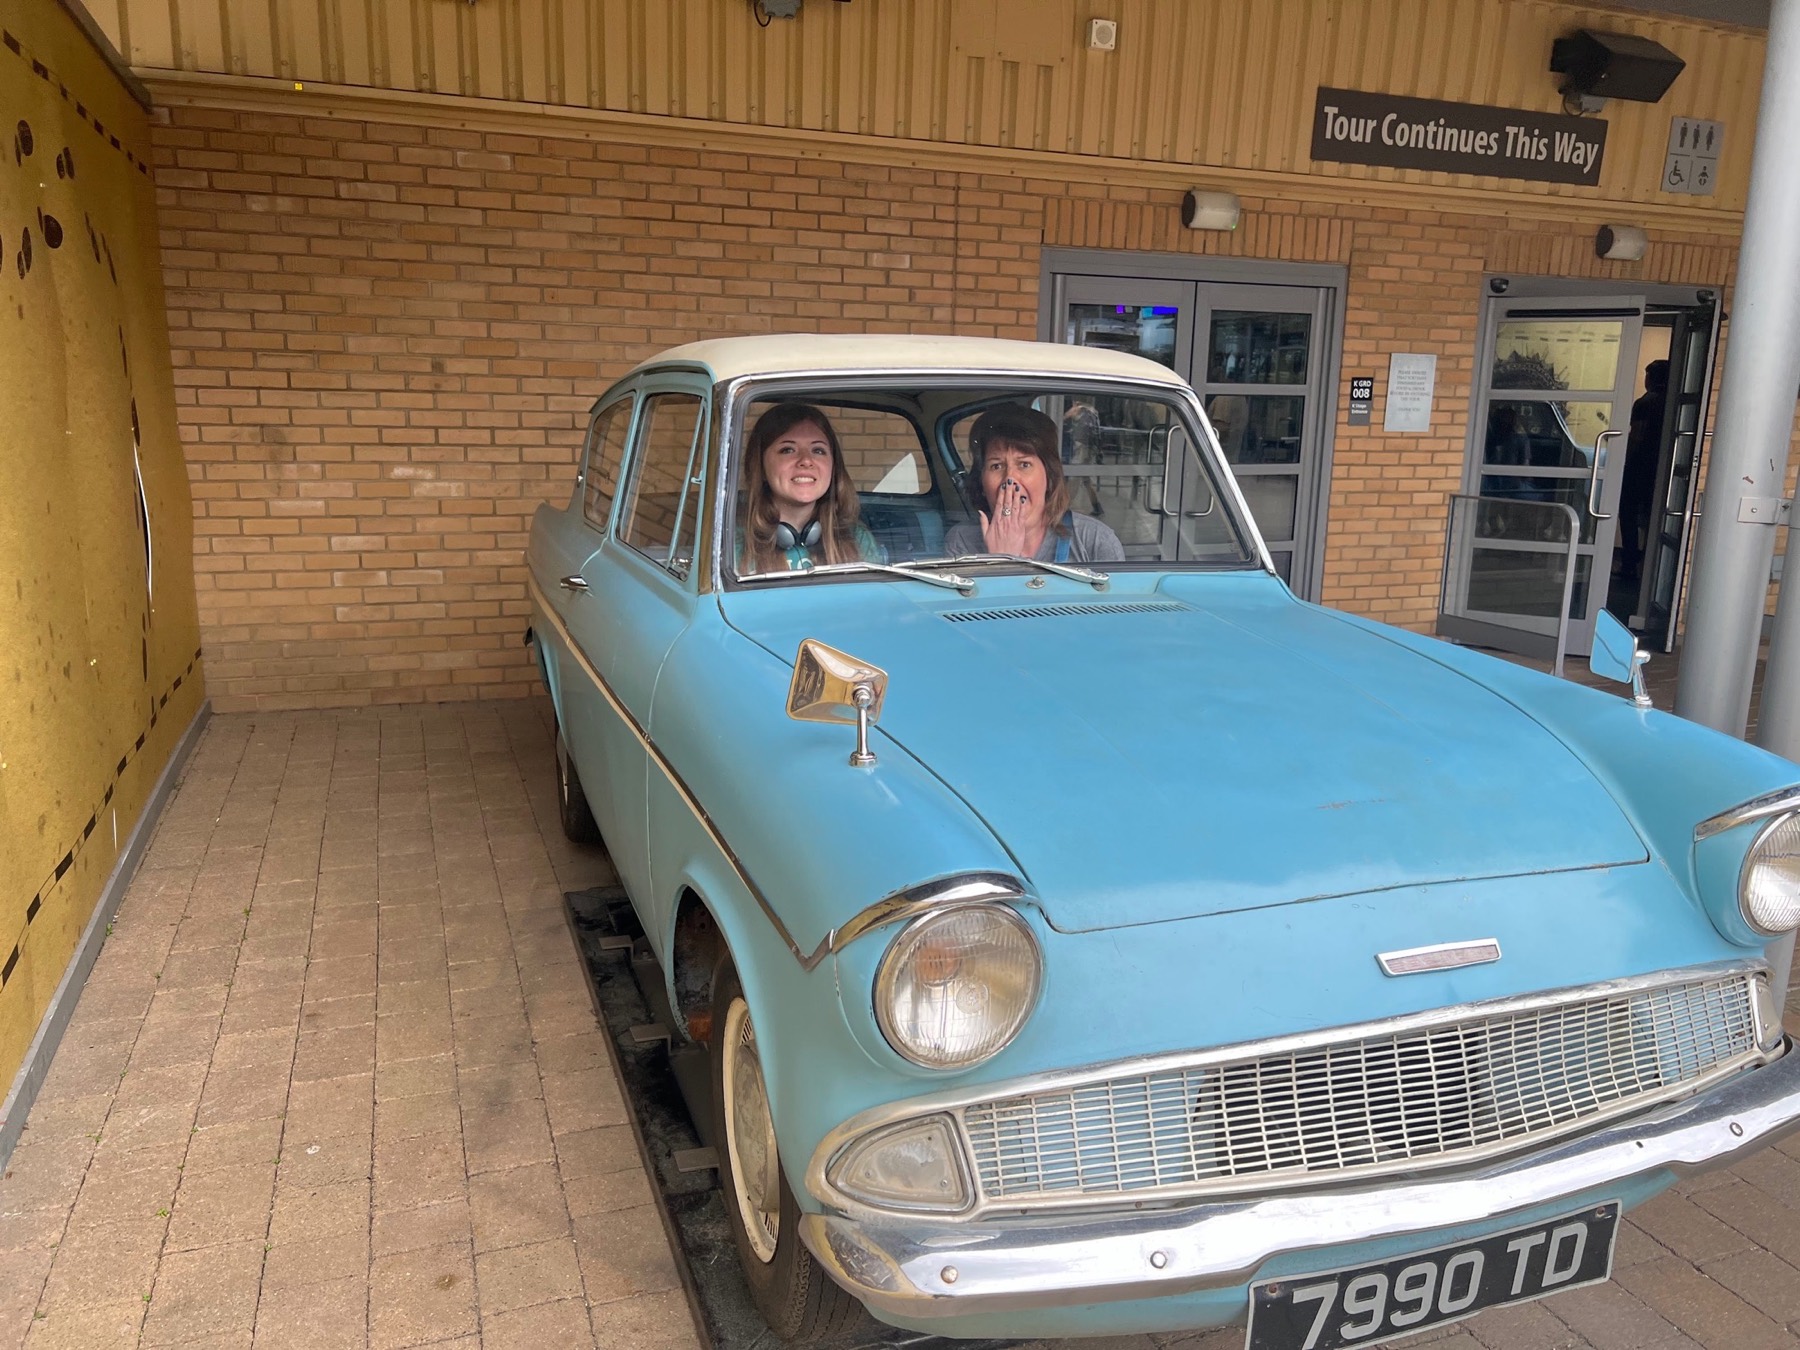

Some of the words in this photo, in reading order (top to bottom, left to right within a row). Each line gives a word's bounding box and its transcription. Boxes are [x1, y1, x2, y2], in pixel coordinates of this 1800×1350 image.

[1323, 105, 1377, 143] Tour
[1381, 113, 1499, 156] Continues
[1505, 125, 1549, 161] This
[1554, 131, 1599, 174] Way
[1352, 388, 1370, 398] 008
[1292, 1250, 1485, 1350] 7990
[1507, 1222, 1588, 1295] TD
